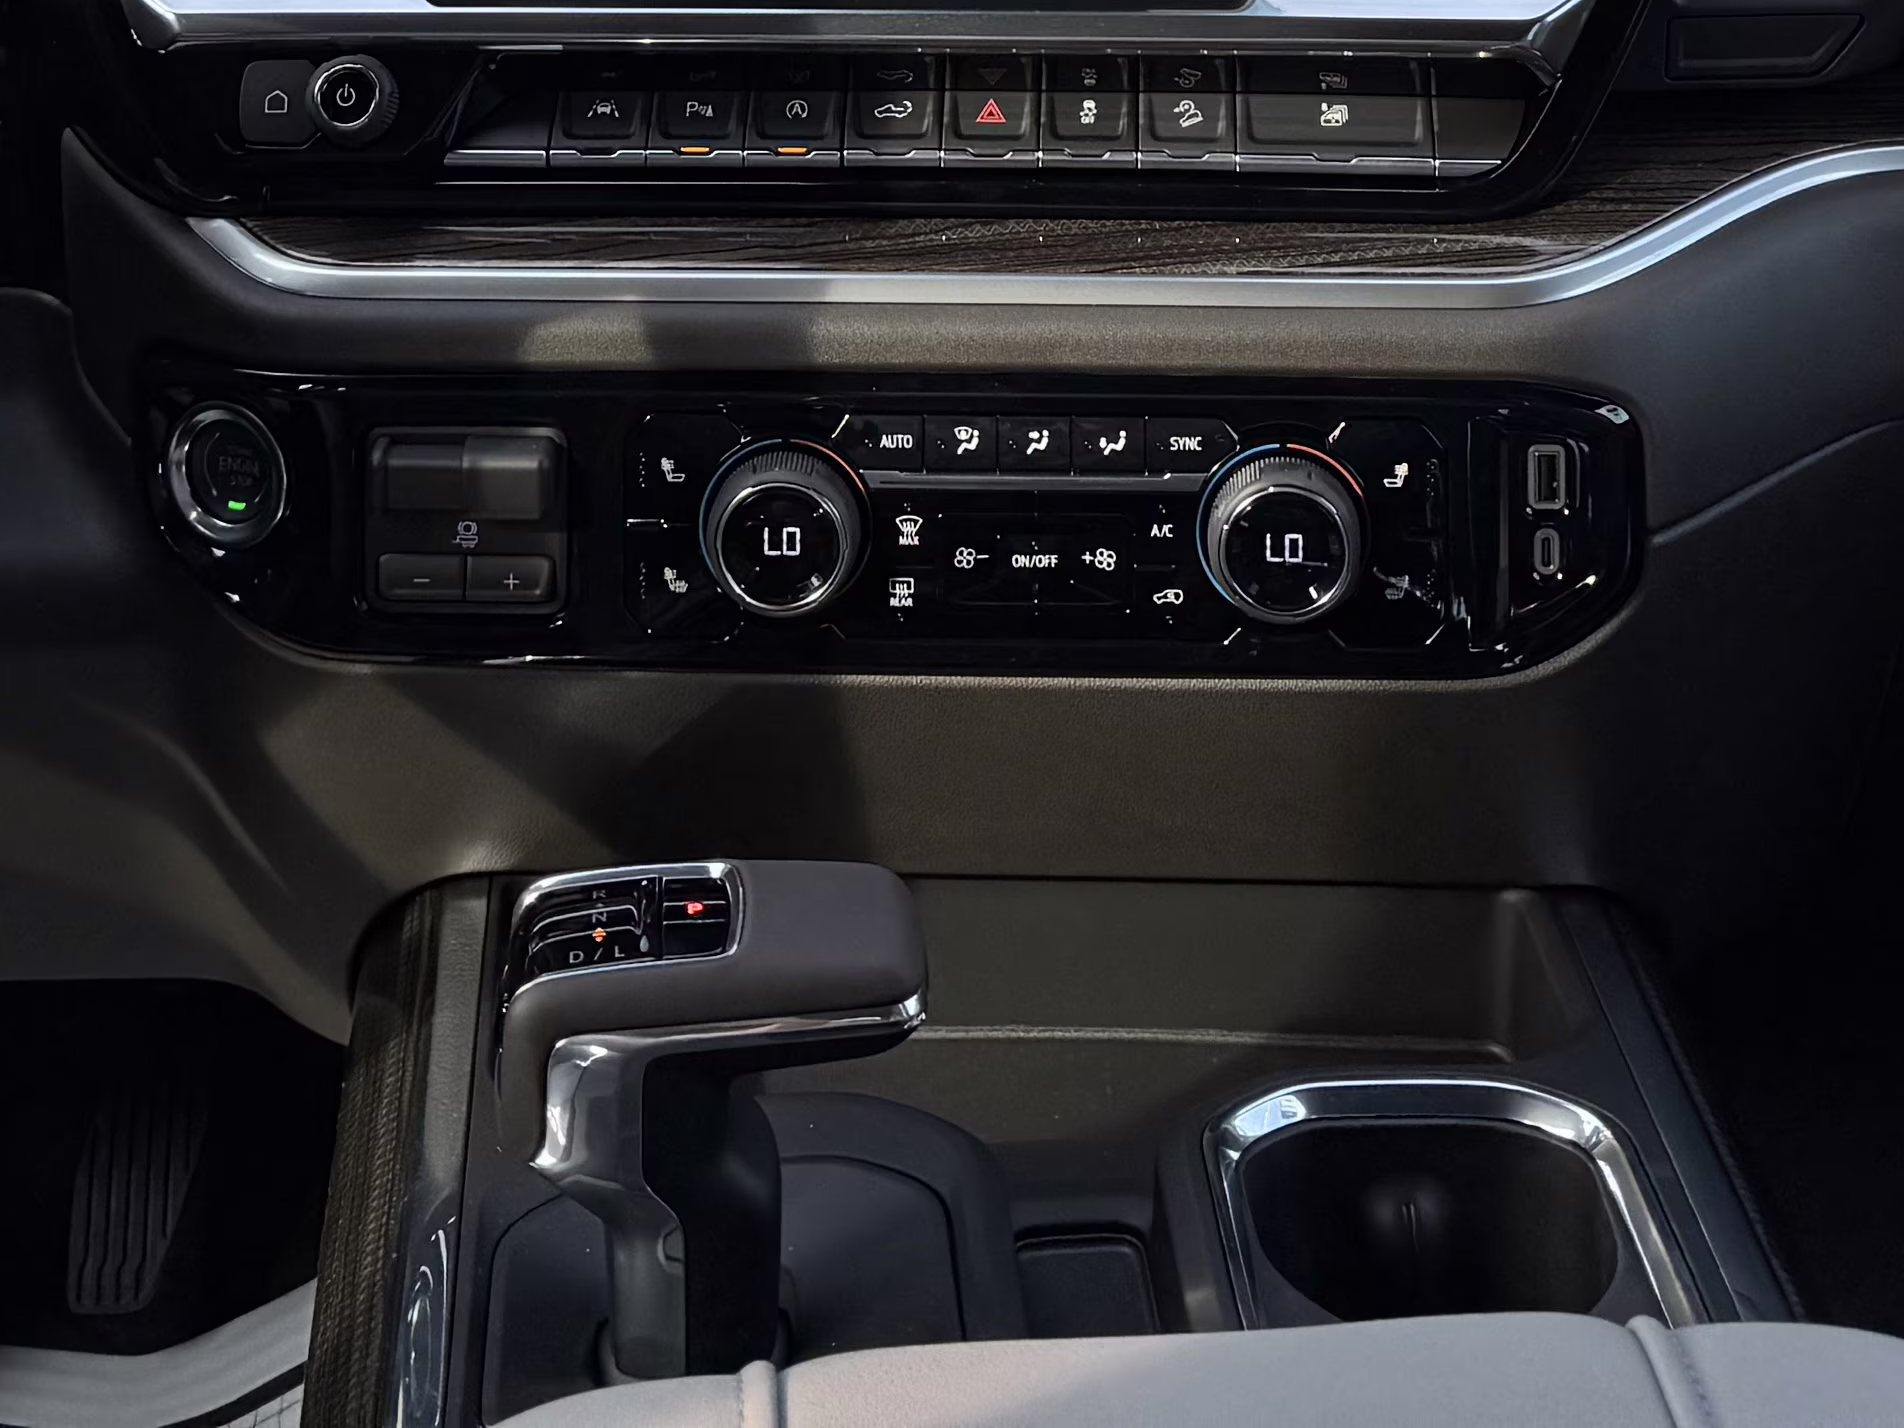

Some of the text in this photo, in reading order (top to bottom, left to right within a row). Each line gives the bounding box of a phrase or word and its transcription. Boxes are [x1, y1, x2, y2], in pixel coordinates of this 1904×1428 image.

[880, 434, 913, 449] AUTO
[1169, 436, 1203, 451] SYNC
[1150, 524, 1174, 538] A/C
[1011, 554, 1059, 568] ON/OFF
[592, 889, 607, 900] R
[687, 902, 704, 915] P
[592, 912, 607, 923] N
[569, 945, 625, 964] D L
